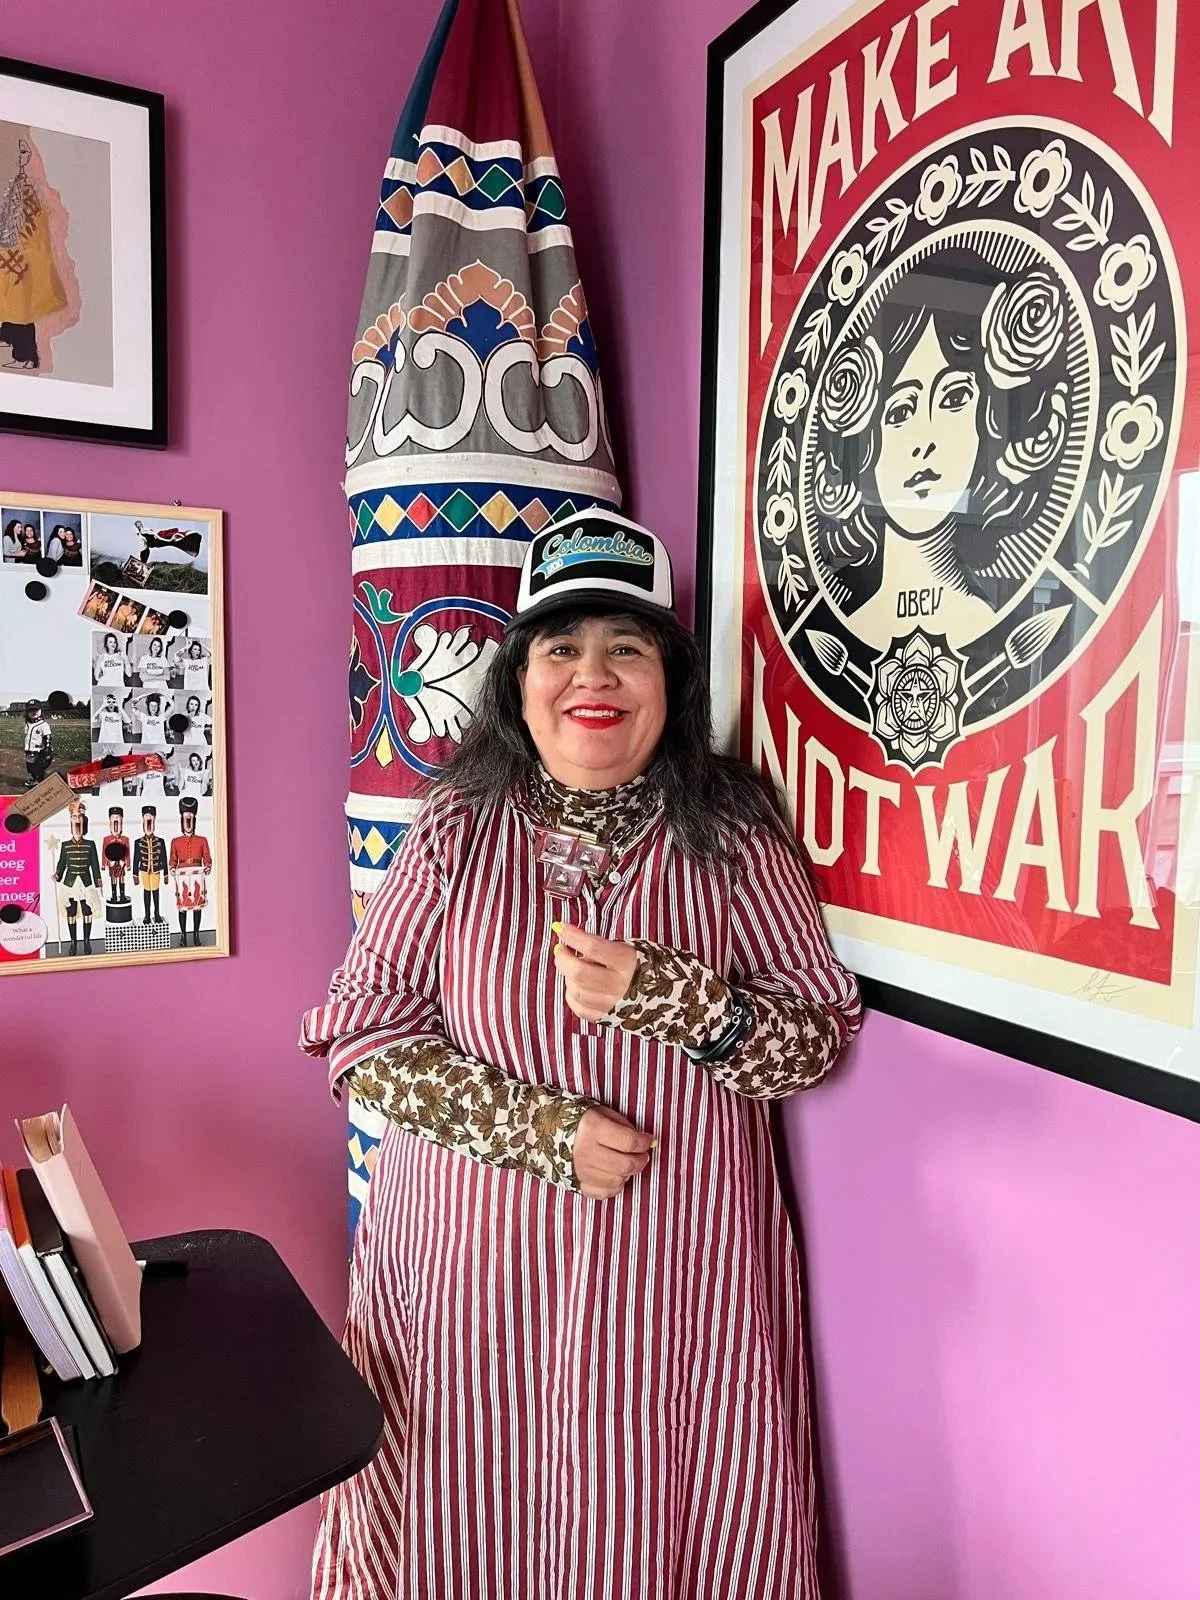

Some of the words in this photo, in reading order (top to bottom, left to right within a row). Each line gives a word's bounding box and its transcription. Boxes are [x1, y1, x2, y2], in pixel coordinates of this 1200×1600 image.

[760, 0, 960, 360] MAKE
[542, 527, 654, 564] Colombia
[897, 586, 944, 618] OBEY
[752, 633, 901, 876] NOT
[915, 592, 1165, 930] WAR
